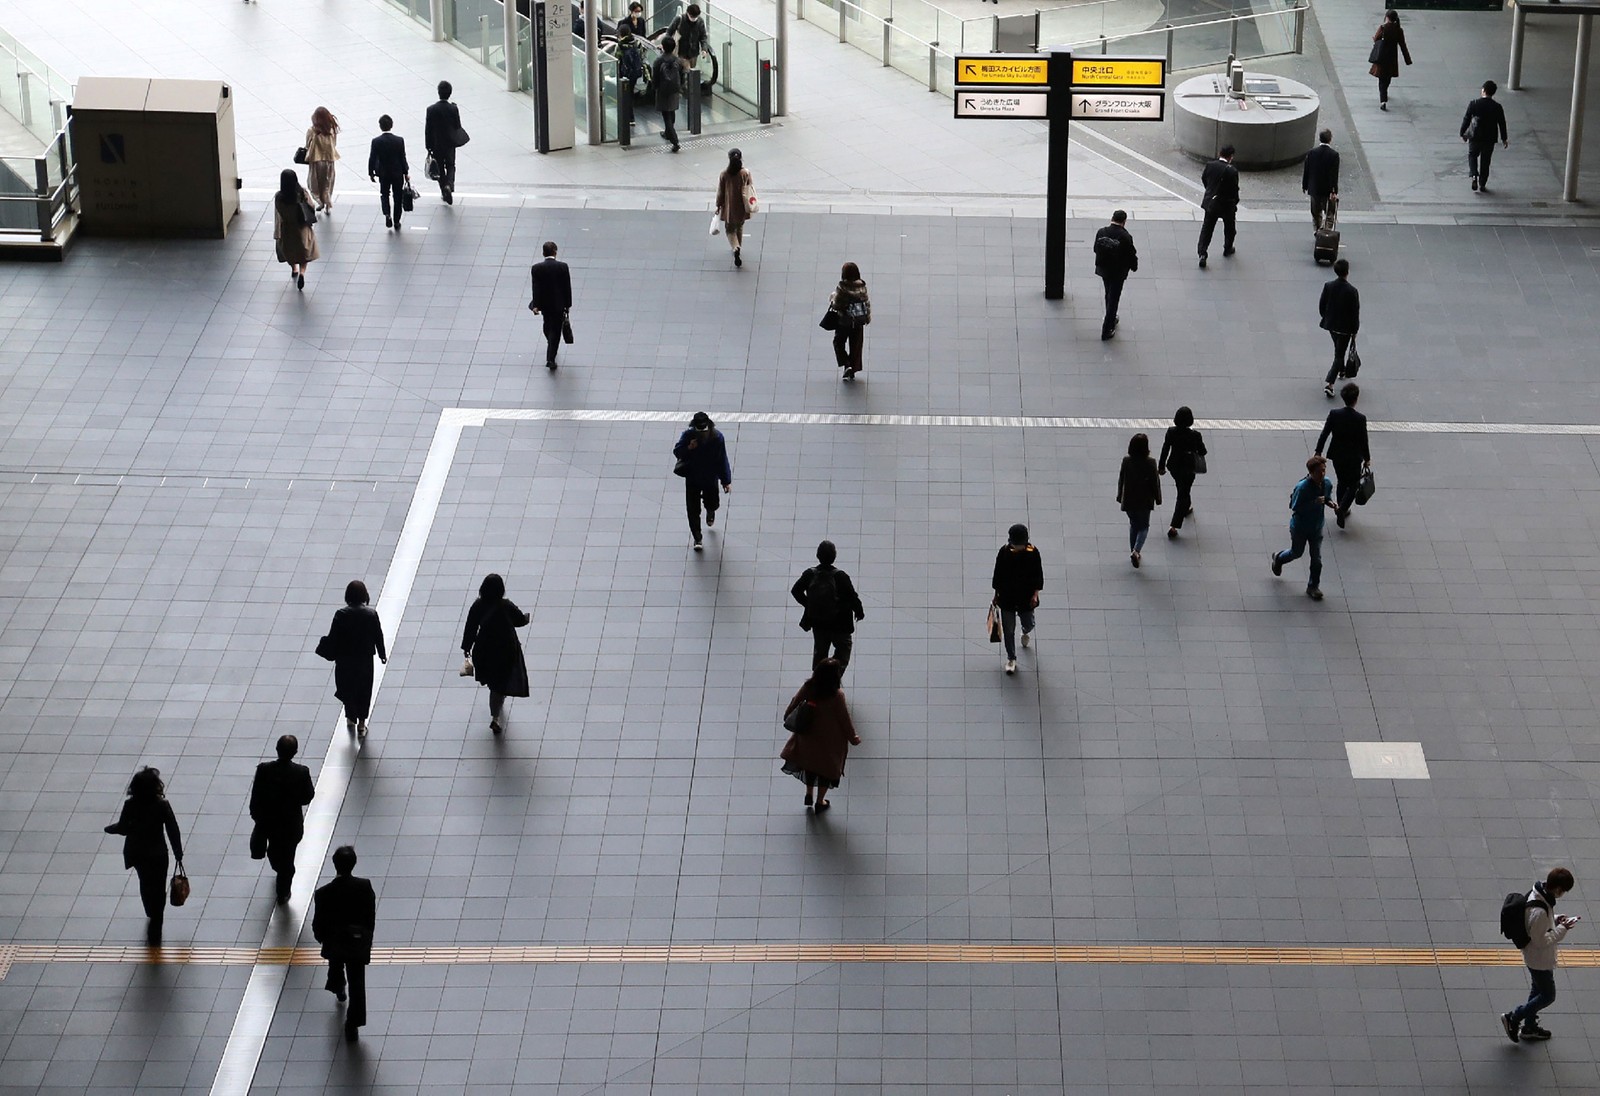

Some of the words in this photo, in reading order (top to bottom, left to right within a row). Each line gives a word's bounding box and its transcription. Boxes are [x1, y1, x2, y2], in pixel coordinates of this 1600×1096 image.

[552, 4, 564, 15] 2F
[981, 65, 1041, 73] 梅田スカイビル方面
[1082, 66, 1114, 74] 中央北口
[980, 98, 1020, 106] うめきた広場
[1095, 100, 1152, 108] グランフロント大阪
